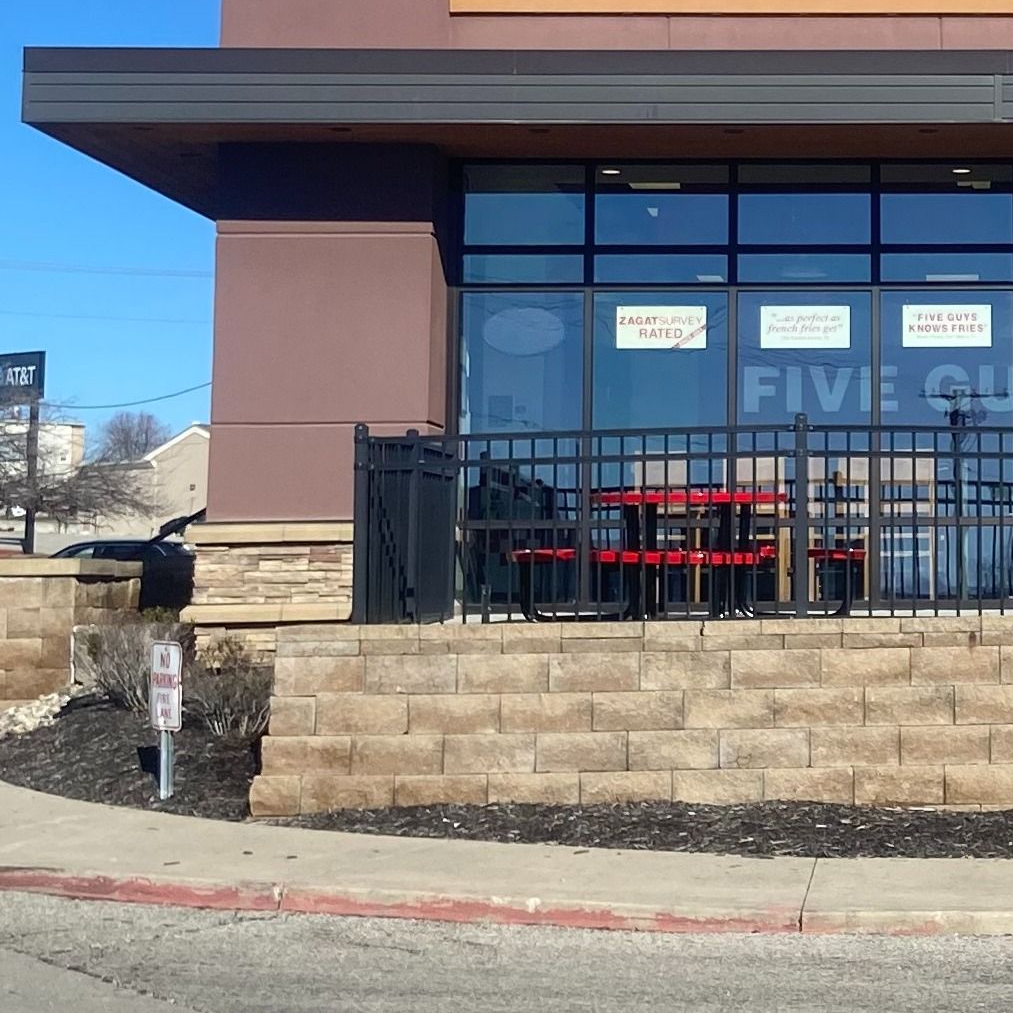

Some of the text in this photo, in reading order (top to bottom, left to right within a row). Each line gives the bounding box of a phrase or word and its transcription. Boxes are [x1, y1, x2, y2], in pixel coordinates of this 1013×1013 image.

[796, 314, 829, 325] perfect
[947, 313, 978, 322] GUYS
[639, 328, 683, 339] RATED
[767, 324, 798, 335] french
[799, 324, 821, 334] fries
[908, 324, 949, 333] KNOWS
[5, 366, 36, 386] AT&T
[743, 365, 899, 413] FIVE
[160, 652, 171, 668] NO
[152, 672, 177, 689] PARKING
